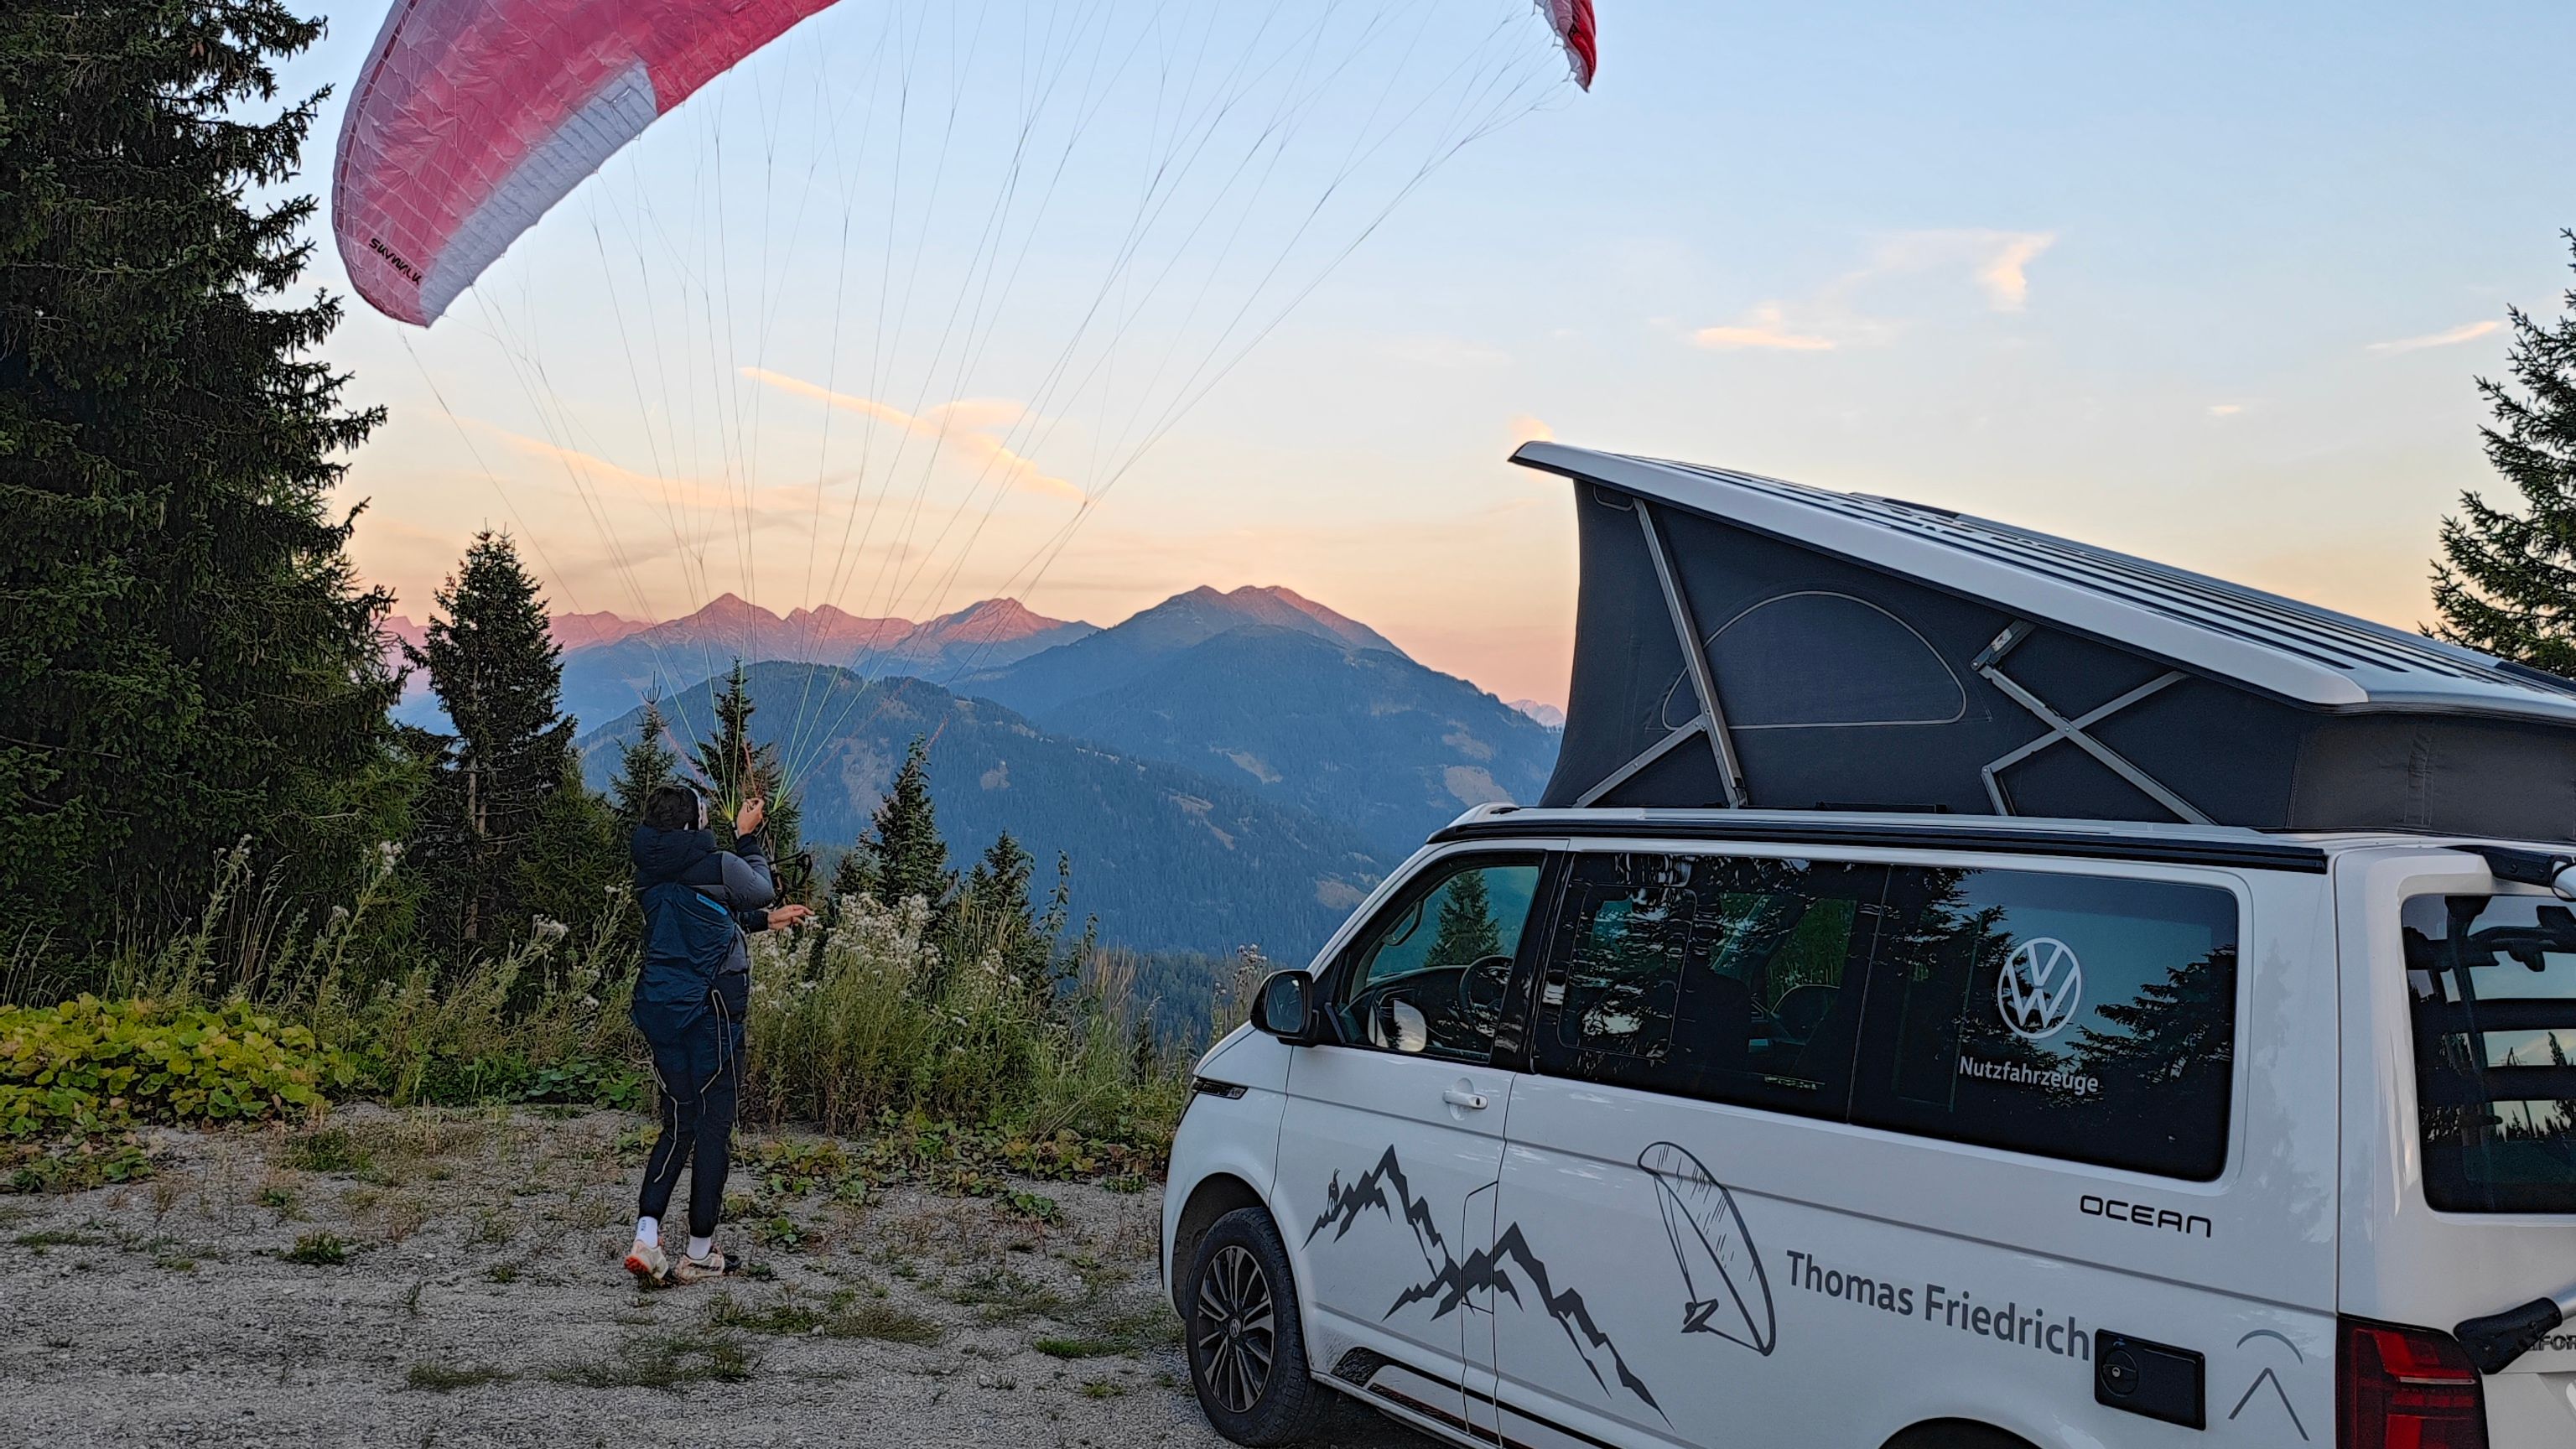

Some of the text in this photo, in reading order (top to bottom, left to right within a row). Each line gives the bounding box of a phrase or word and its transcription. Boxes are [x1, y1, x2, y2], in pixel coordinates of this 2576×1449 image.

[369, 238, 422, 285] SKYWALK
[1959, 1056, 2098, 1096] Nutzfahrzeuge
[2080, 1195, 2212, 1239] OCEAN
[1787, 1249, 2090, 1361] Thomas Friedrich
